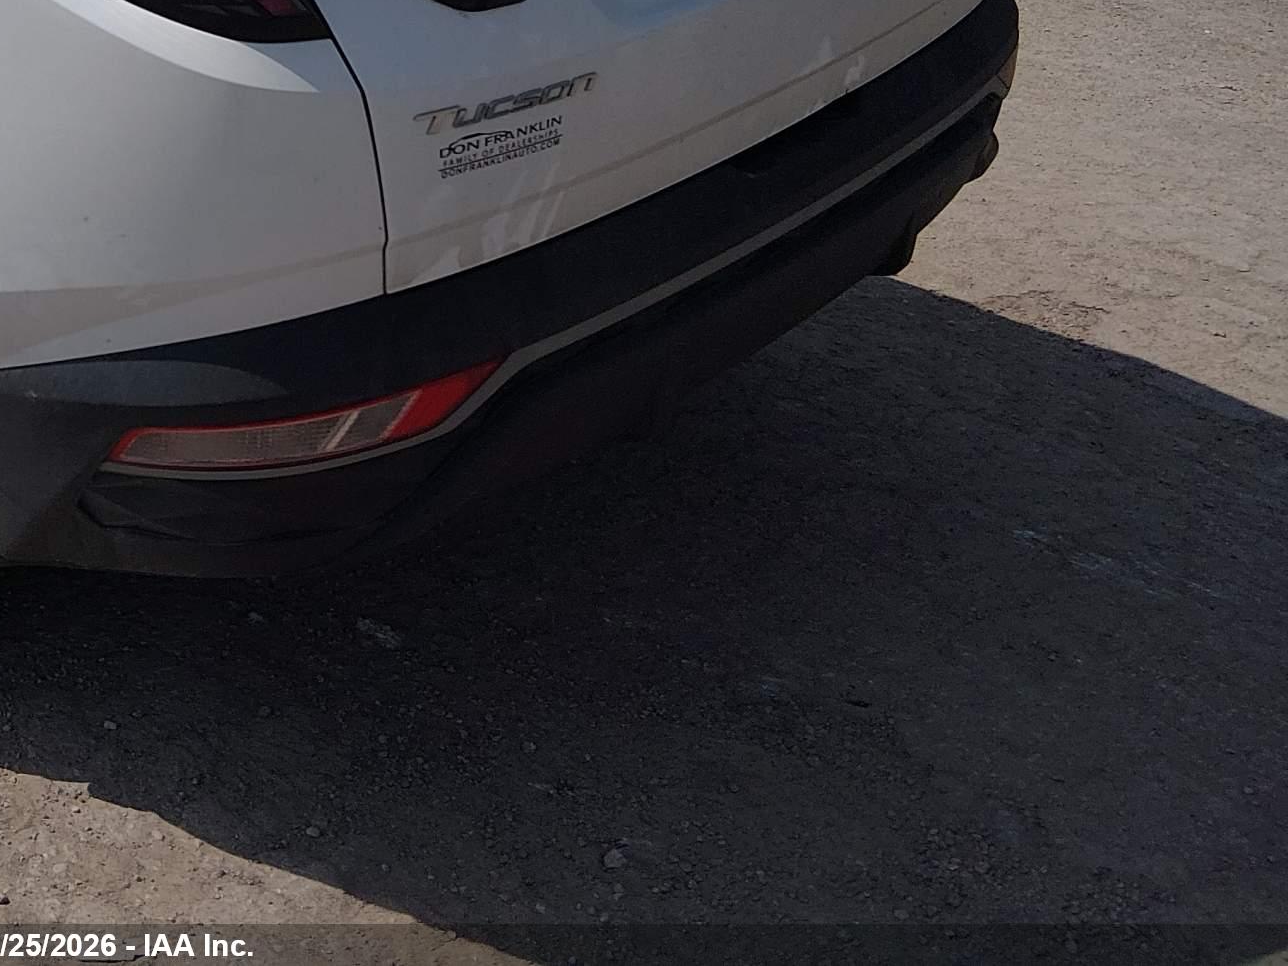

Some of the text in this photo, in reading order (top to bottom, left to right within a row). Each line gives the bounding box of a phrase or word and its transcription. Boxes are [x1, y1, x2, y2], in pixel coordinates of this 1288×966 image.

[439, 115, 563, 159] DON FRANKLIN
[442, 128, 560, 168] FAMILY OF DEALERSHIPS
[441, 138, 561, 178] DONFRANKLINAUTO.COM
